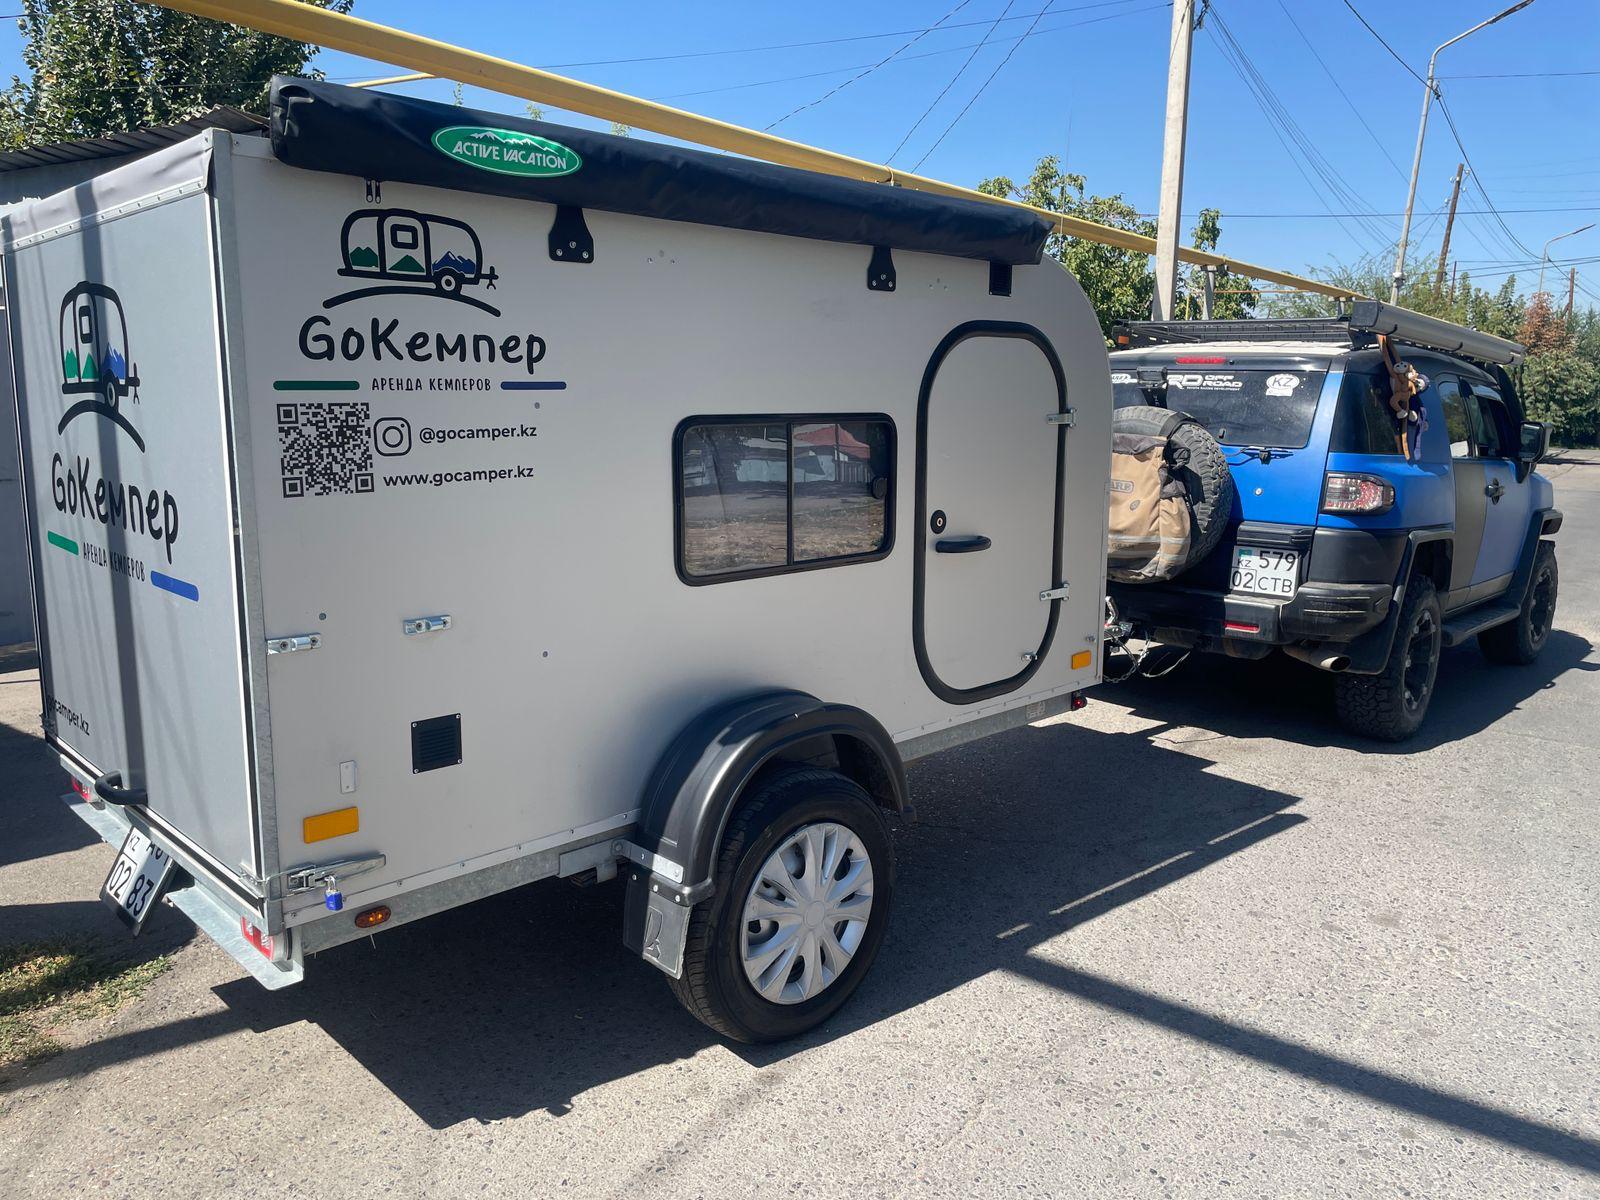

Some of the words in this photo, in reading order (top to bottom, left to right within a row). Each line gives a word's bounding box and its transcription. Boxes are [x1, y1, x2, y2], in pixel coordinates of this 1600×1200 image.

[452, 140, 500, 161] ACTIVE
[503, 147, 567, 170] VACATION
[371, 377, 423, 392] АРЕНДА
[429, 377, 492, 392] КЕМПЕРОВ
[1202, 380, 1243, 388] ROAD
[1272, 376, 1294, 387] KZ
[419, 424, 537, 444] @gocamper.kz
[383, 465, 534, 487] www.gocamper.kz
[83, 541, 108, 568] АРЕНДА
[110, 551, 145, 582] КЕМПЕРОВ
[1237, 558, 1252, 568] KZ
[1259, 550, 1296, 572] 579
[1232, 570, 1254, 589] 02
[1258, 576, 1293, 593] CTB
[129, 833, 141, 852] KZ
[109, 860, 132, 900] 02
[126, 873, 155, 917] 83
